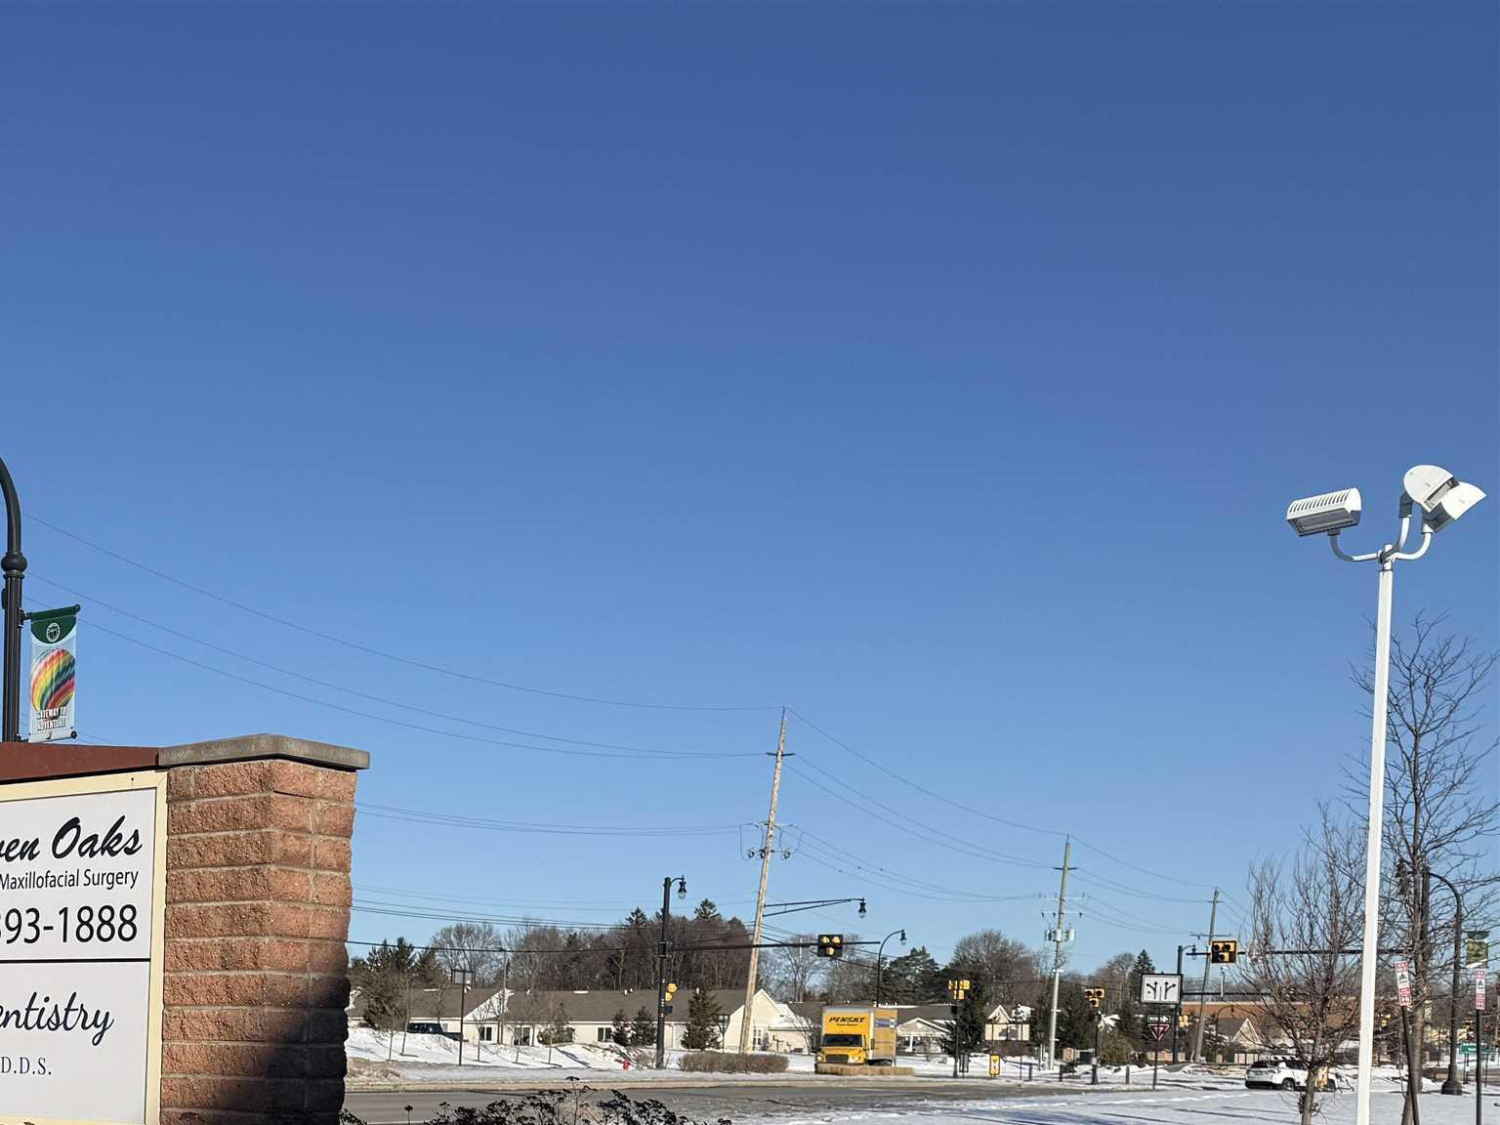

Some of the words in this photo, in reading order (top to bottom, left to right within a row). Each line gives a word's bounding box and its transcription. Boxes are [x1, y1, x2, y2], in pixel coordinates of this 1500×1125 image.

[51, 815, 143, 860] Oaks
[83, 868, 138, 890] Surgery
[0, 1056, 52, 1076] D.D.S.
